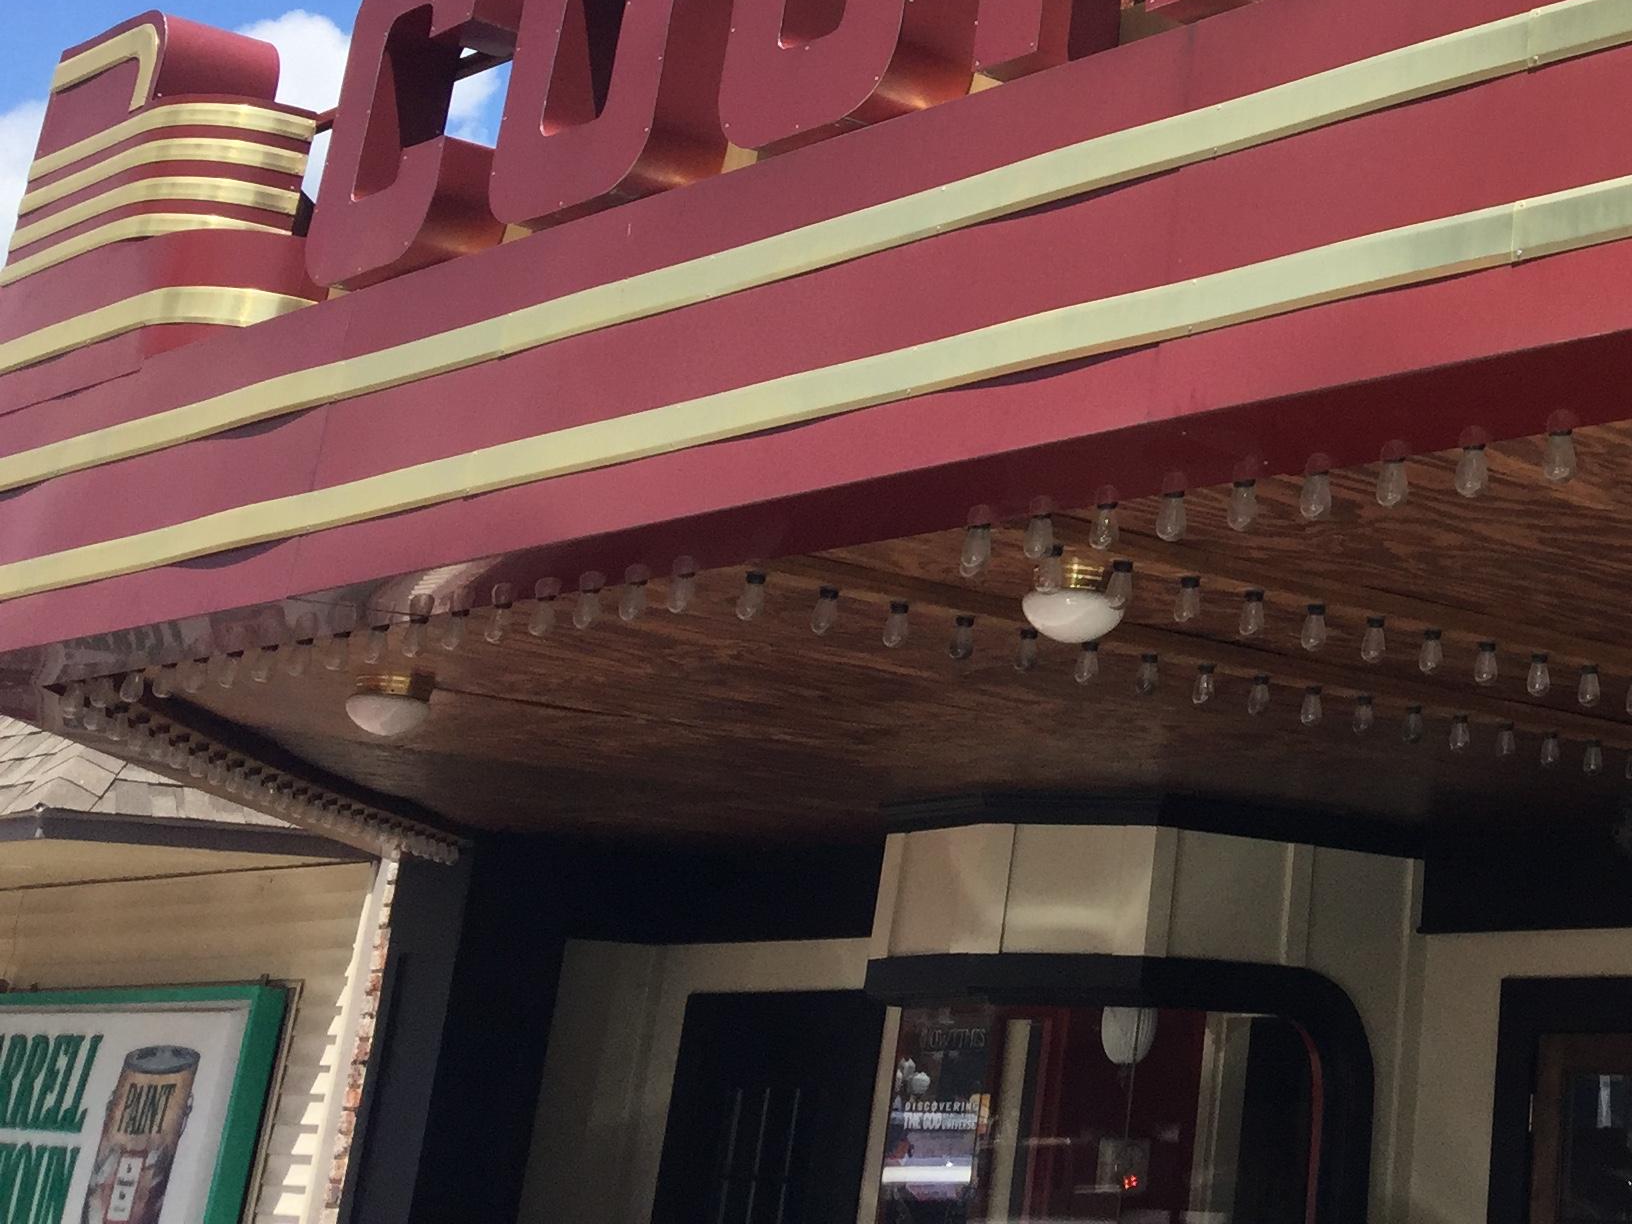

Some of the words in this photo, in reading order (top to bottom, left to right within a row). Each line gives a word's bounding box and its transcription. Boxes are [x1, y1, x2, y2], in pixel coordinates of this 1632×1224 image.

[0, 1033, 102, 1134] RRELL
[116, 1082, 178, 1136] PAINT
[903, 1112, 923, 1130] THE
[904, 1101, 978, 1112] DISCOVERING
